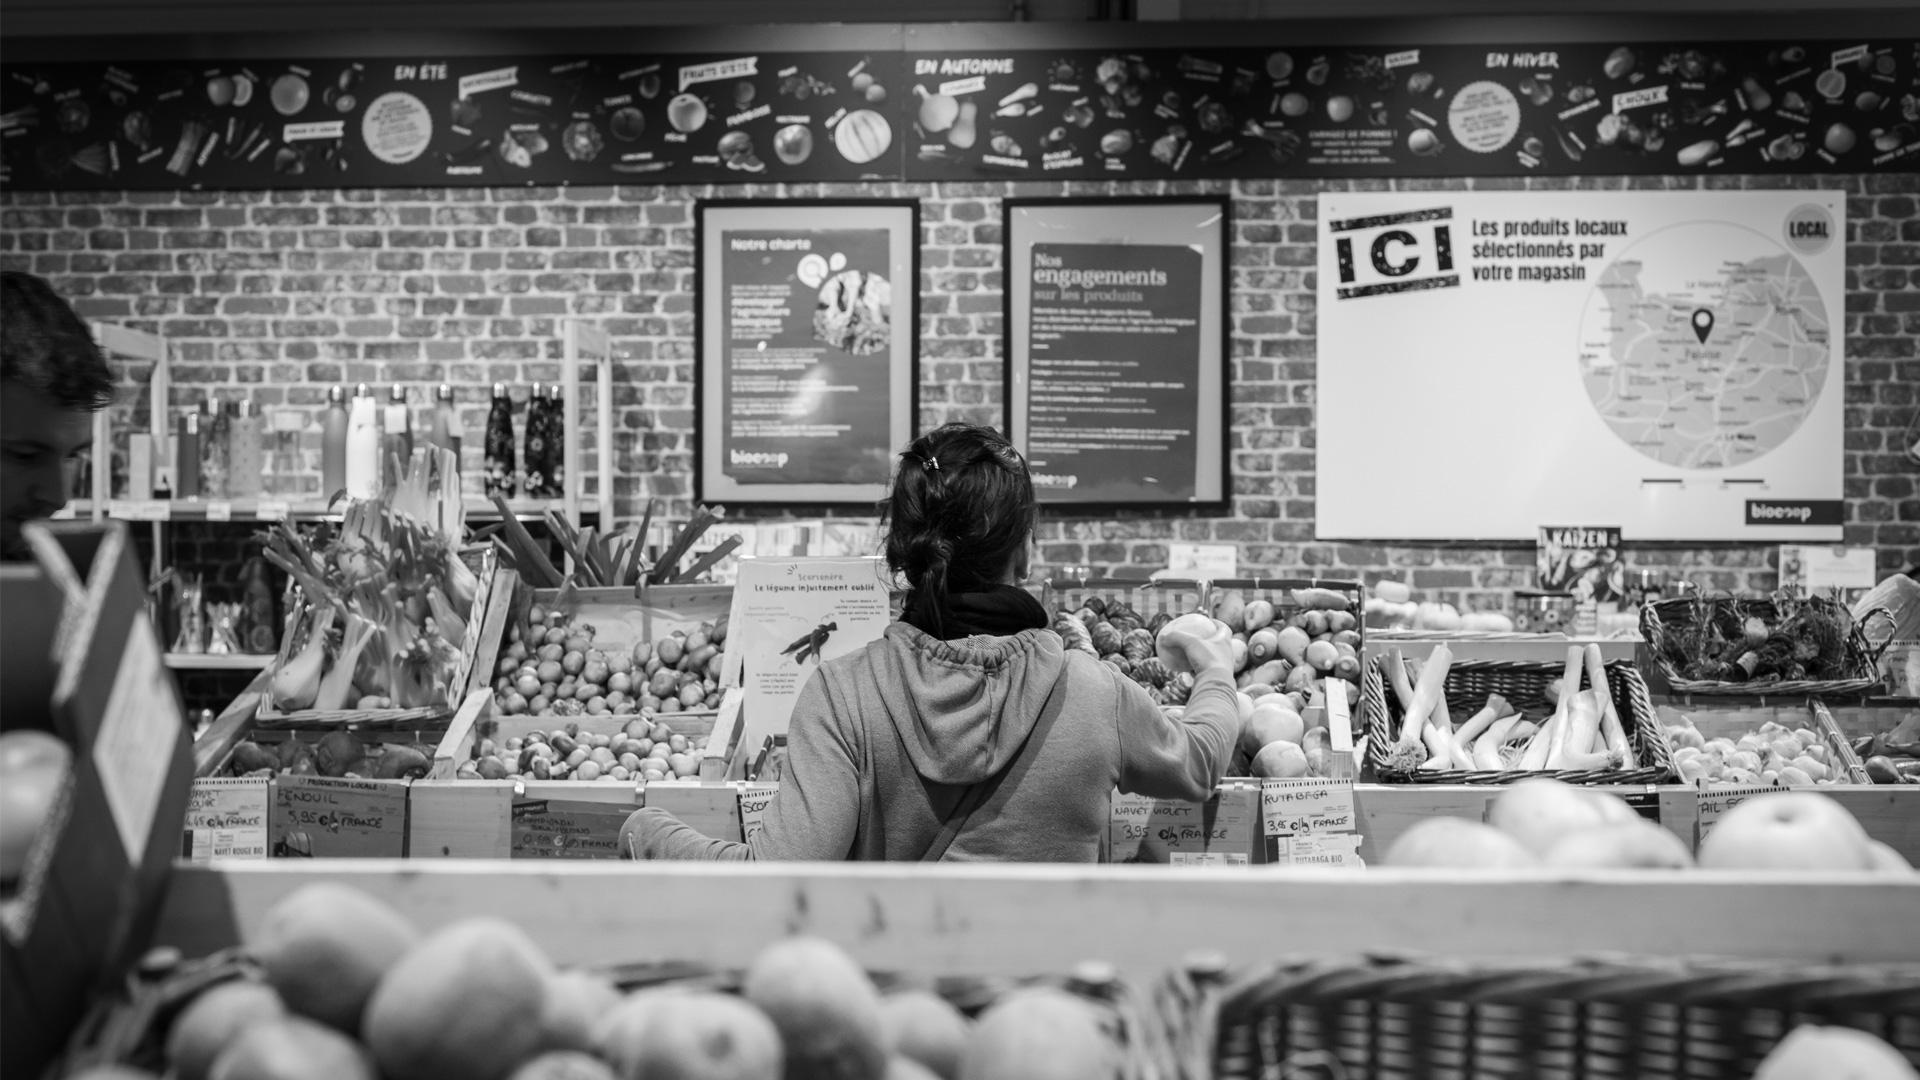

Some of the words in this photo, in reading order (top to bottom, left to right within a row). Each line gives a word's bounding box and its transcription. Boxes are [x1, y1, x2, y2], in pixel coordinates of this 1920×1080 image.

[914, 59, 939, 76] EN
[940, 58, 1015, 76] AUTOMNE
[1486, 52, 1510, 68] EN
[1512, 52, 1560, 69] HIVER
[394, 65, 417, 81] EN
[1472, 219, 1498, 237] Les
[1503, 218, 1570, 239] produits
[1575, 218, 1628, 237] locaux
[1789, 220, 1829, 239] LOCAL
[731, 238, 768, 251] Notre
[769, 237, 811, 251] charte
[1472, 240, 1574, 259] sélectionnés
[1579, 243, 1605, 261] par
[1034, 253, 1063, 268] Nos
[1337, 225, 1453, 283] ICI
[1033, 266, 1168, 289] engagements
[1472, 264, 1512, 281] votre
[1518, 263, 1586, 283] magasin
[1034, 290, 1058, 301] sur
[1060, 288, 1080, 301] les
[1083, 288, 1144, 304] produits
[754, 584, 764, 592] Le
[766, 583, 795, 594] légume
[797, 584, 848, 593] injustement
[851, 583, 875, 592] oublié
[307, 778, 350, 789] PRODUCTION
[350, 782, 378, 791] LOCALE
[277, 789, 339, 805] FENOUIL
[1264, 789, 1328, 805] RUTABAGA
[1115, 806, 1149, 816] NAVET
[1153, 806, 1192, 817] VIOLET
[1701, 800, 1721, 814] AIL
[226, 816, 260, 827] FRANCE
[288, 810, 318, 826] 5,95
[341, 817, 383, 829] FRANCE
[1313, 815, 1348, 829] FRANCE
[1122, 824, 1151, 840] 3,95
[1180, 828, 1228, 840] FRANCE
[1295, 854, 1330, 865] RUTABAGA
[1330, 853, 1343, 864] BIO
